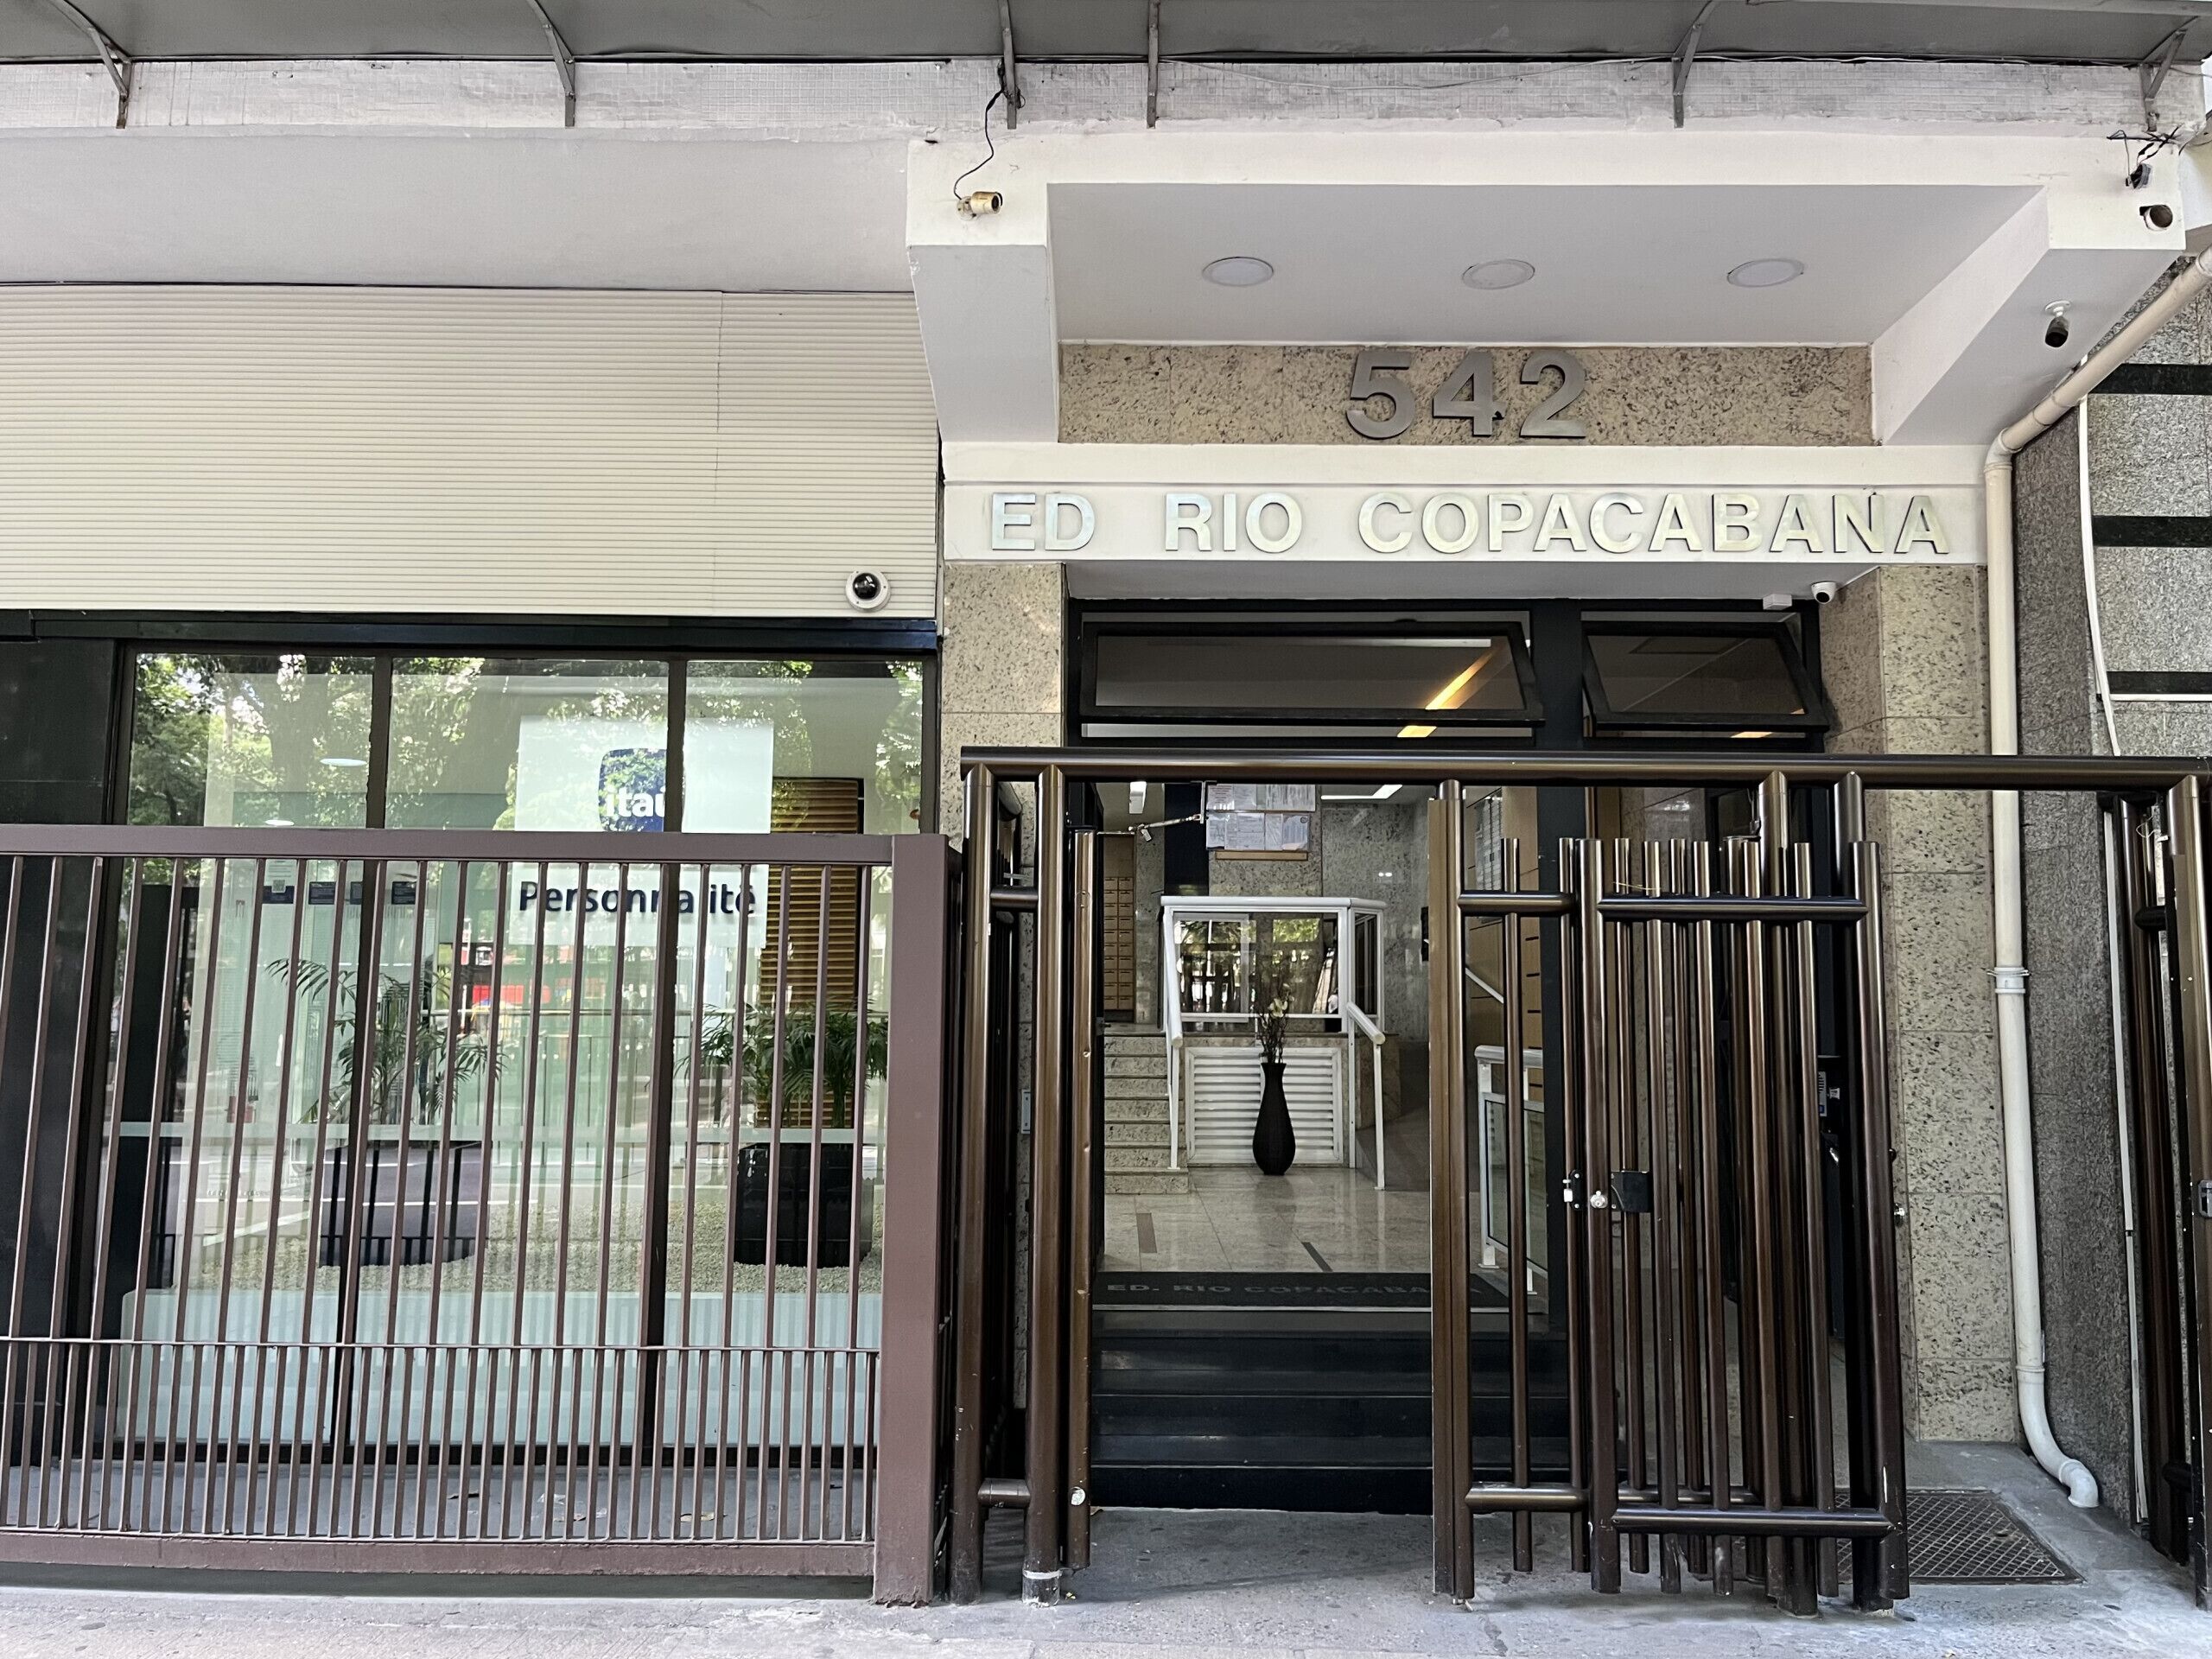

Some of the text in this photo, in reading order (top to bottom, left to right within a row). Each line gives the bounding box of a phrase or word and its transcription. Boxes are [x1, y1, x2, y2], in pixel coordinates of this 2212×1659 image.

[1345, 349, 1588, 439] 542
[991, 493, 1950, 555] ED RIO COPACABANA
[1173, 1284, 1231, 1293] RIO
